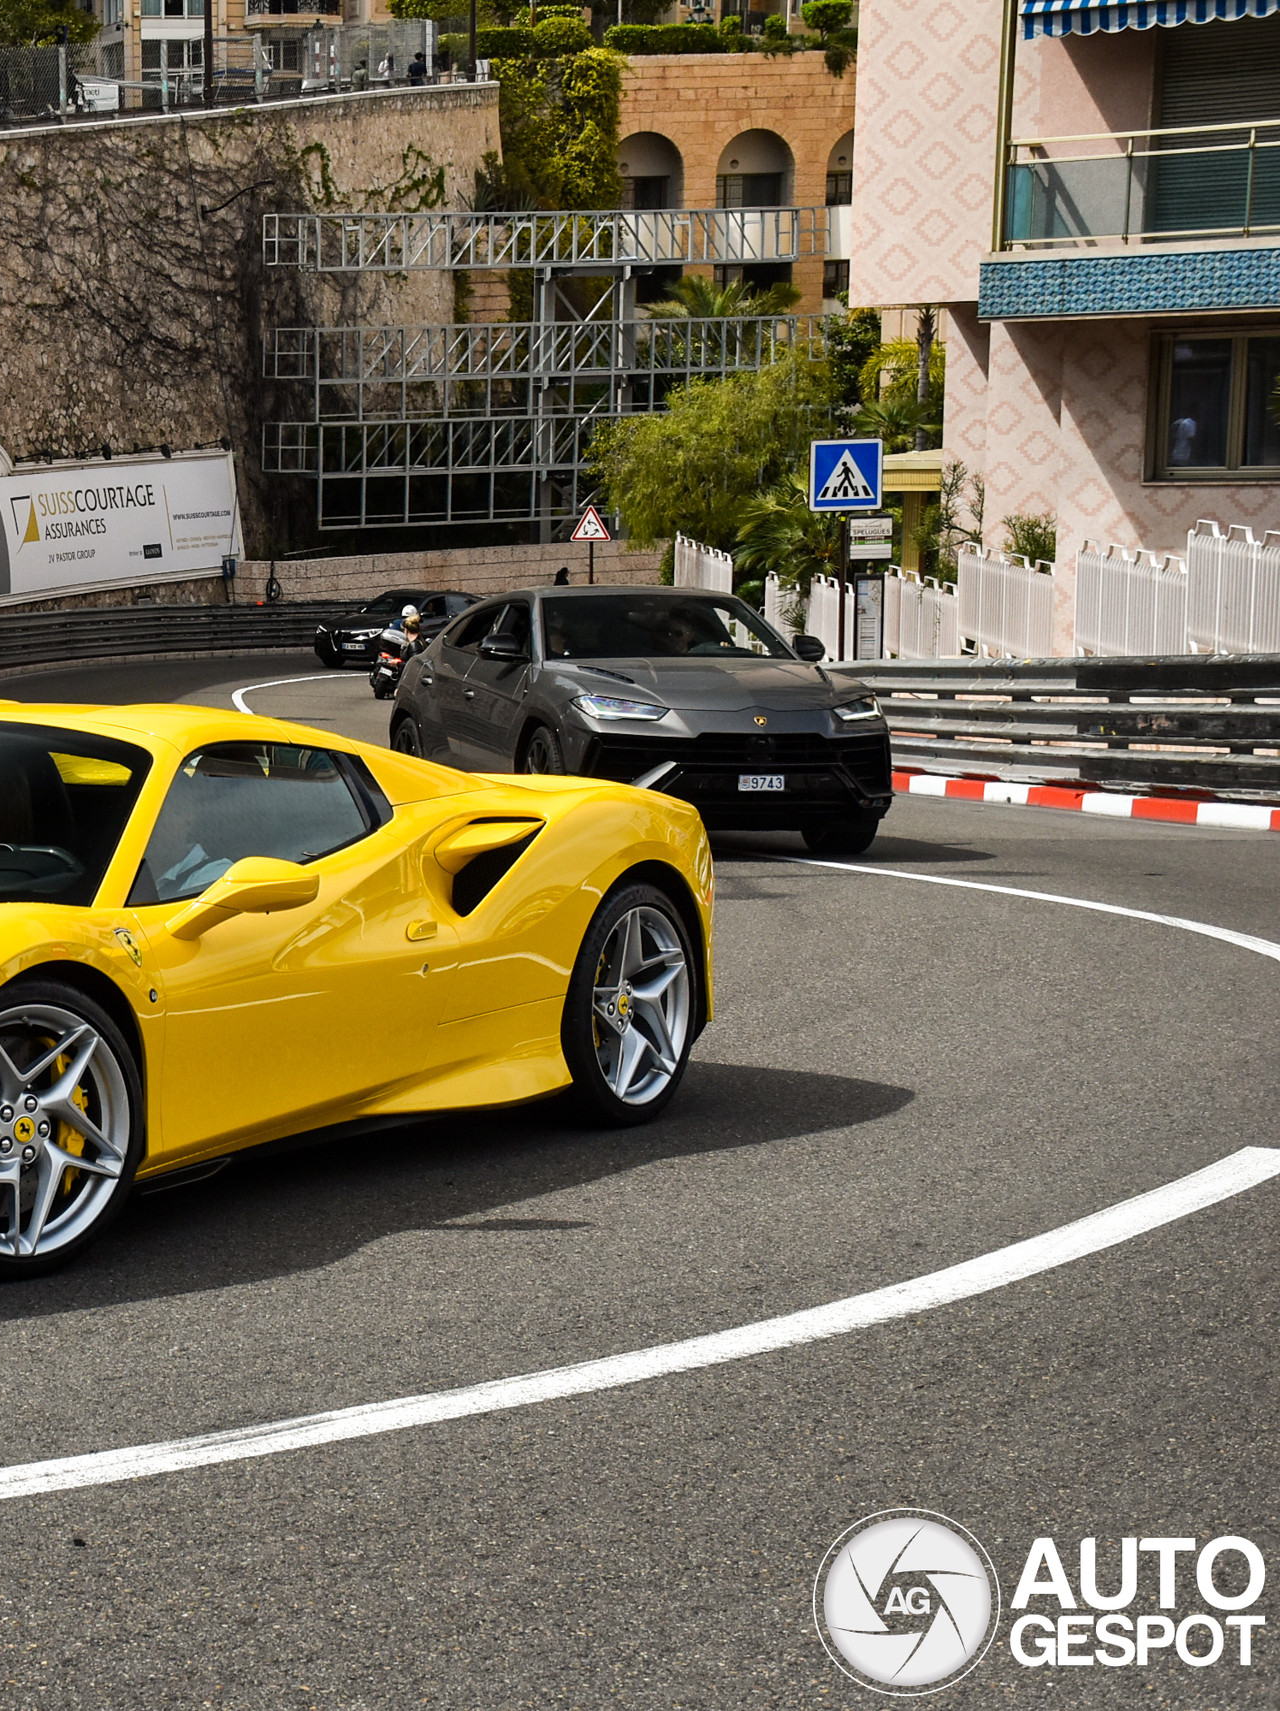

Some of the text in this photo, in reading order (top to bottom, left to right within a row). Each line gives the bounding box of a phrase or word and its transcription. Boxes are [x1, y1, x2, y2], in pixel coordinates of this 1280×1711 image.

[38, 484, 155, 516] SUISSCOURTAGE
[173, 510, 231, 520] WWW.SUISSCOURTAGE.COM
[45, 518, 107, 540] ASSURANCES
[852, 528, 891, 536] SPELUGUES
[48, 549, 96, 564] JV PASTOR GROUP
[751, 777, 783, 790] 9743
